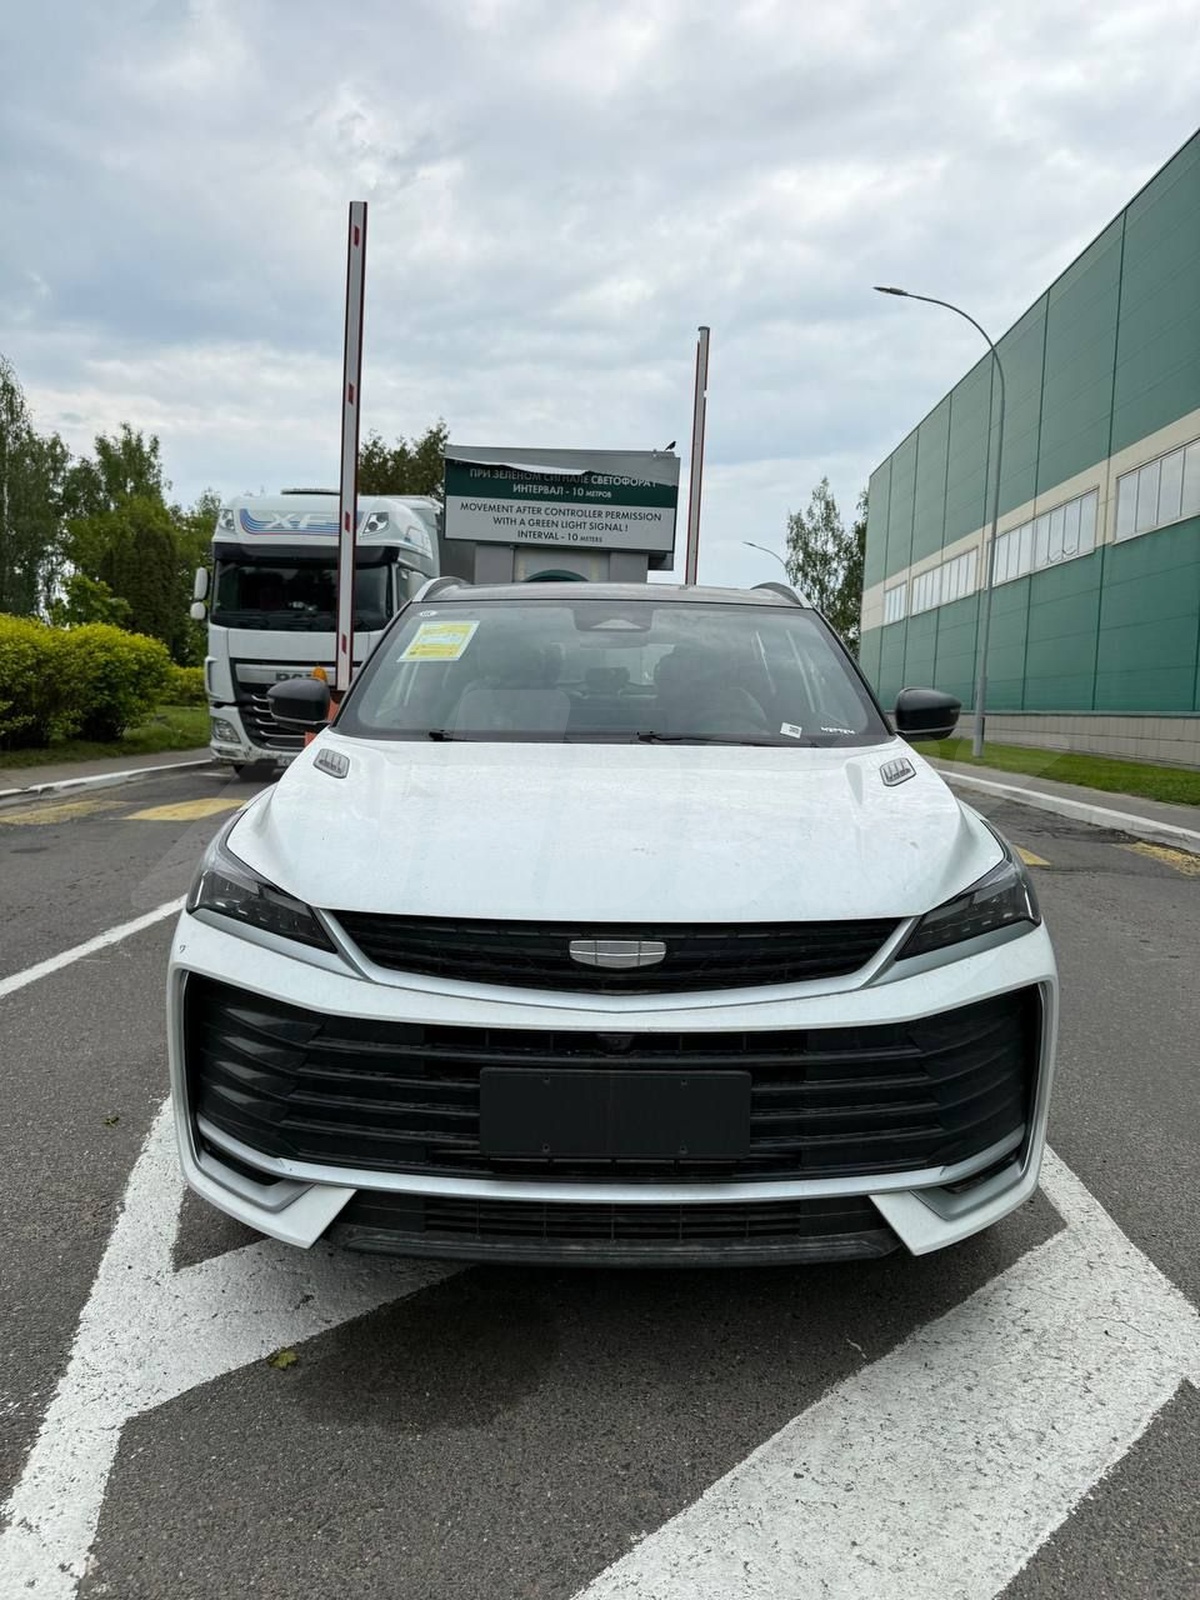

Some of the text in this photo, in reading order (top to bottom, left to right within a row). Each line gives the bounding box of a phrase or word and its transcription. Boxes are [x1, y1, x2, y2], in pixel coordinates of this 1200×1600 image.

[469, 468, 491, 479] ПРИ
[513, 484, 563, 495] ИНТЕРВАЛ
[572, 486, 584, 497] 10
[460, 502, 662, 521] MOVEMENT AFTER CONTROLLER PERMISSION
[492, 516, 517, 526] WITH
[519, 518, 526, 527] A
[527, 518, 559, 529] GREEN
[561, 520, 587, 530] LIGHT
[517, 530, 559, 540] INTERVAL
[567, 533, 579, 541] 10
